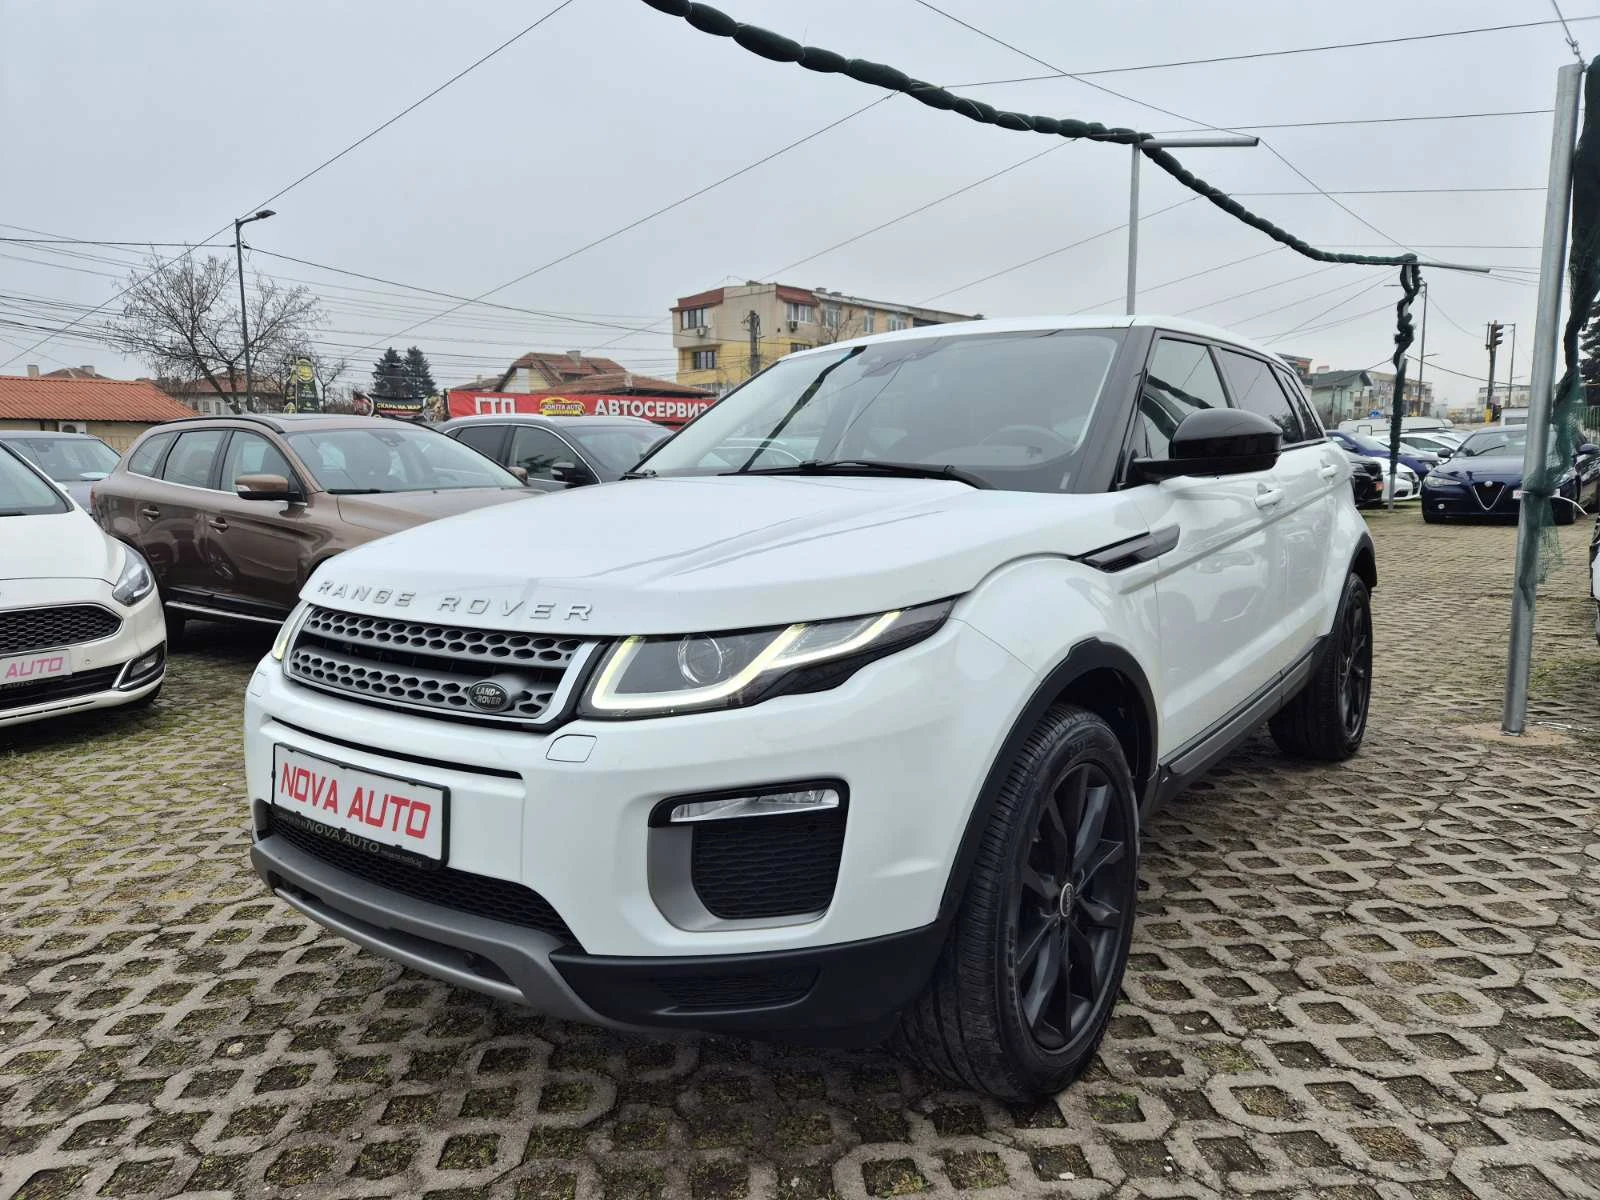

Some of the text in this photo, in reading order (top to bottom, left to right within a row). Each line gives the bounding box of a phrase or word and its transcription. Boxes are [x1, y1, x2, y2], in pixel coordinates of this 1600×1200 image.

[474, 397, 515, 414] ГТП
[317, 581, 593, 621] RANGE ROVER
[5, 656, 64, 678] AUTO
[476, 687, 496, 696] LAND
[476, 696, 502, 705] ROVER
[280, 762, 432, 840] NOVA AUTO
[305, 819, 341, 841] NOVA
[342, 834, 380, 853] AUTO
